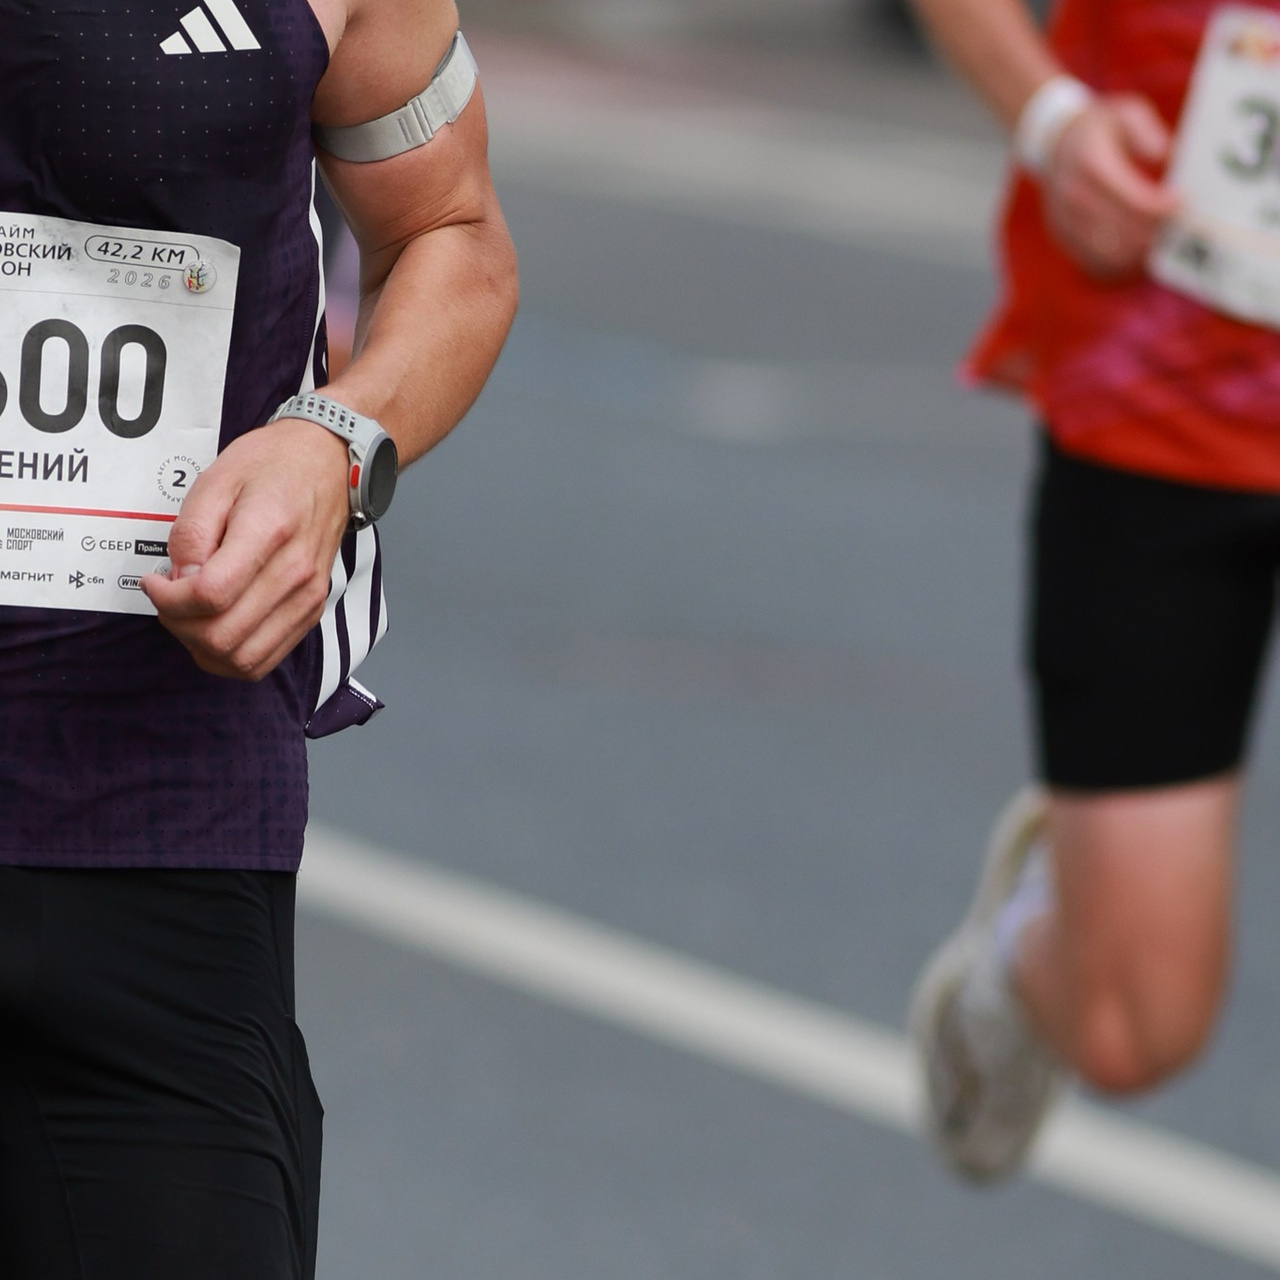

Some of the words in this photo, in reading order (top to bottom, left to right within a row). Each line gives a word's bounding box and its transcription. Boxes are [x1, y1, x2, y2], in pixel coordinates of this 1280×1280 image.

[96, 241, 144, 261] 42,2
[150, 247, 186, 265] КМ
[107, 268, 172, 290] 2026
[172, 469, 187, 488] 2
[157, 478, 185, 502] АРАФОН
[6, 526, 65, 542] МОСКОВСКИЙ
[5, 539, 34, 551] СПОРТ
[99, 539, 133, 552] СБЕР
[137, 543, 164, 554] Прайм
[0, 570, 55, 583] магнит
[87, 576, 106, 585] сбп
